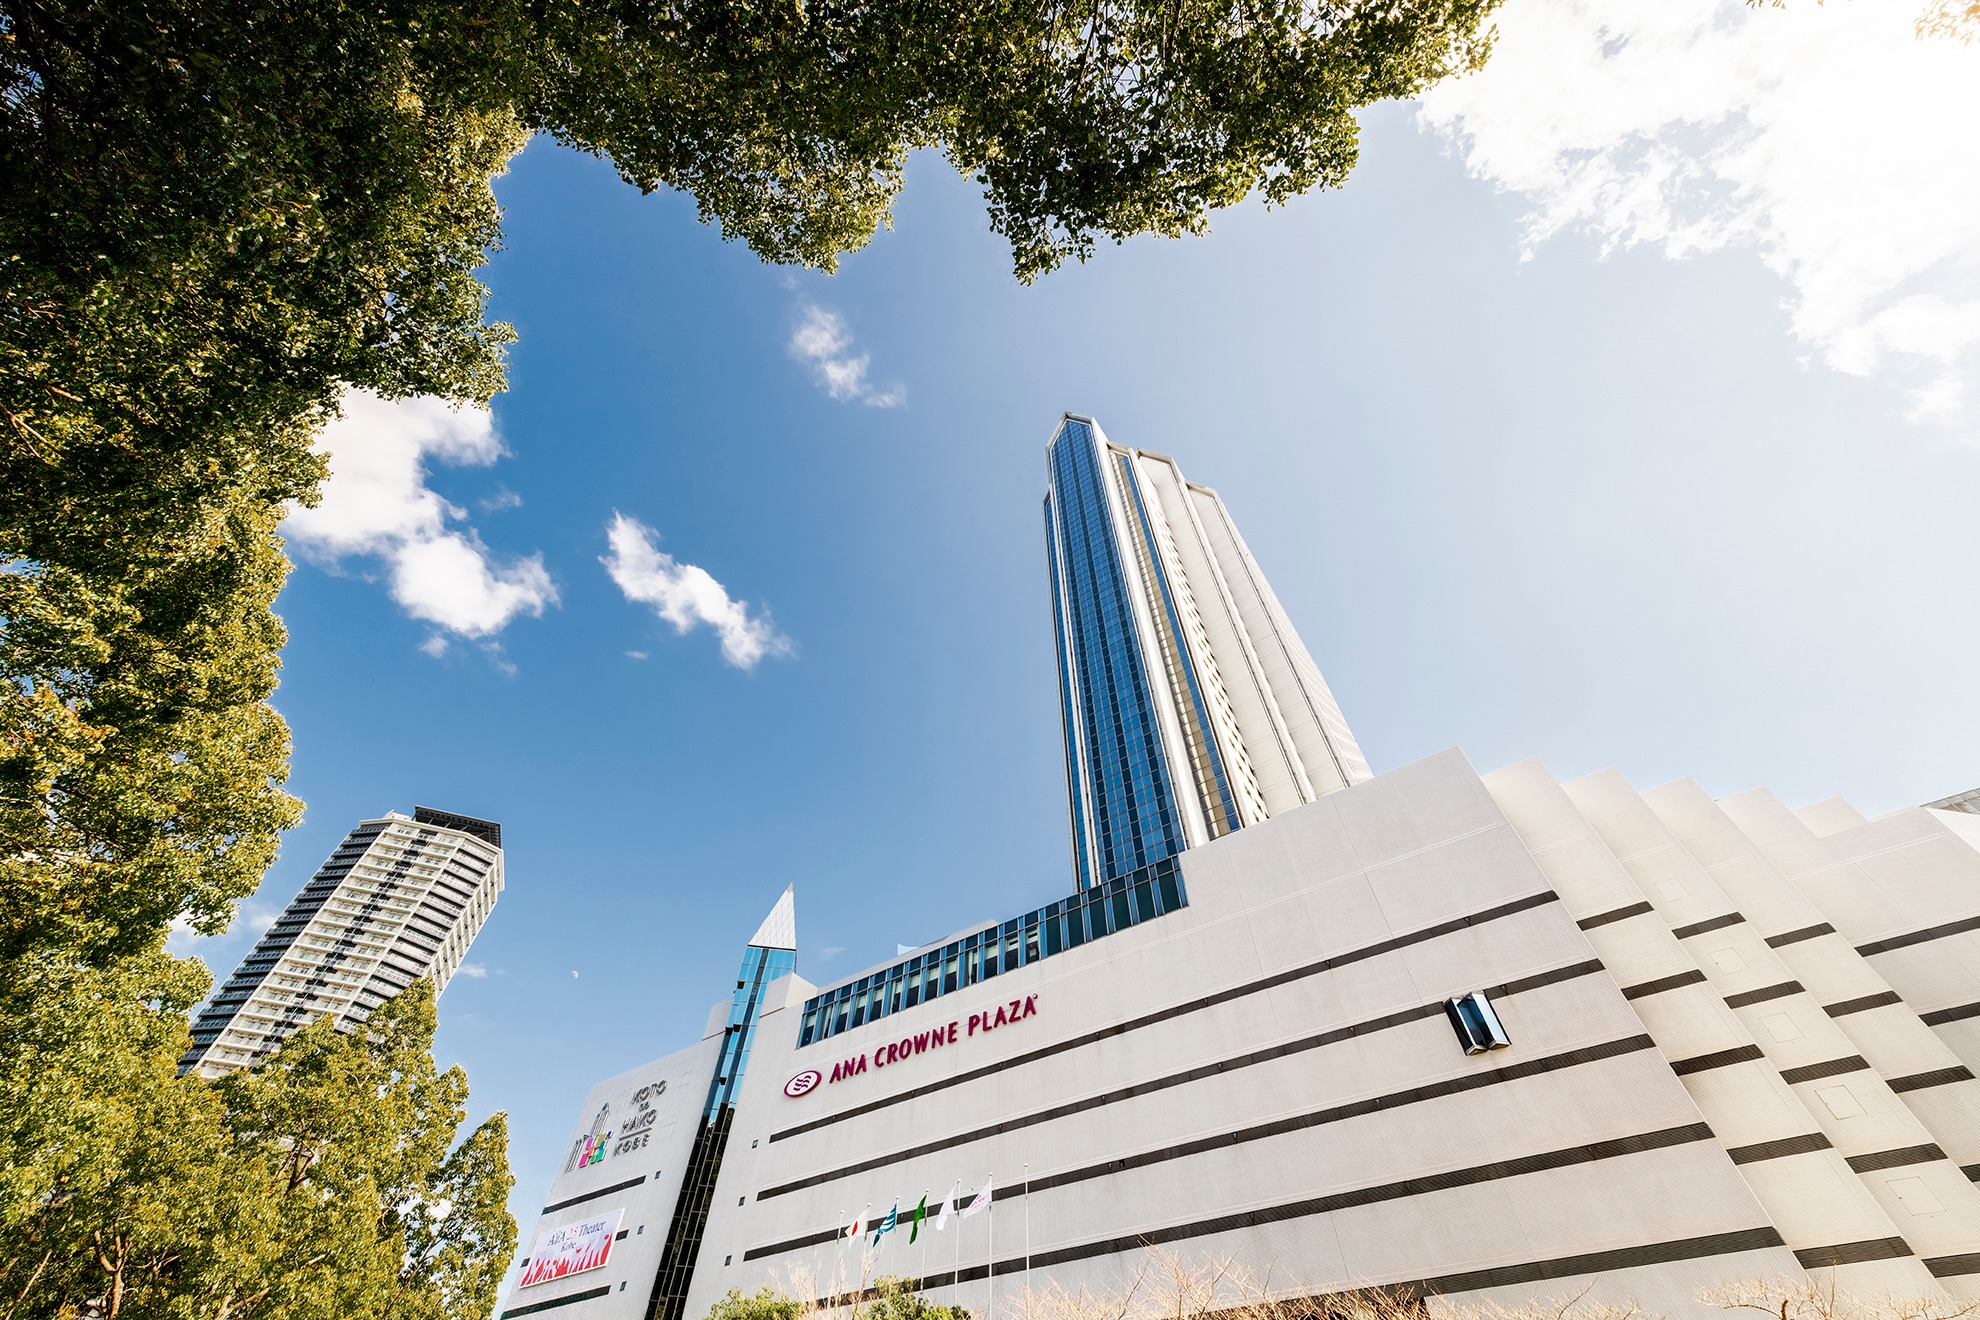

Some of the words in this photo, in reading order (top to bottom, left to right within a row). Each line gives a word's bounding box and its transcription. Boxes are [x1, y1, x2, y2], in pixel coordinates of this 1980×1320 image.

[829, 1054, 867, 1083] ANA
[874, 1021, 959, 1067] CROWNE
[968, 995, 1037, 1037] PLAZA
[631, 1080, 668, 1105] KOTO
[613, 1133, 651, 1156] KOBE
[579, 1221, 606, 1236] Theater
